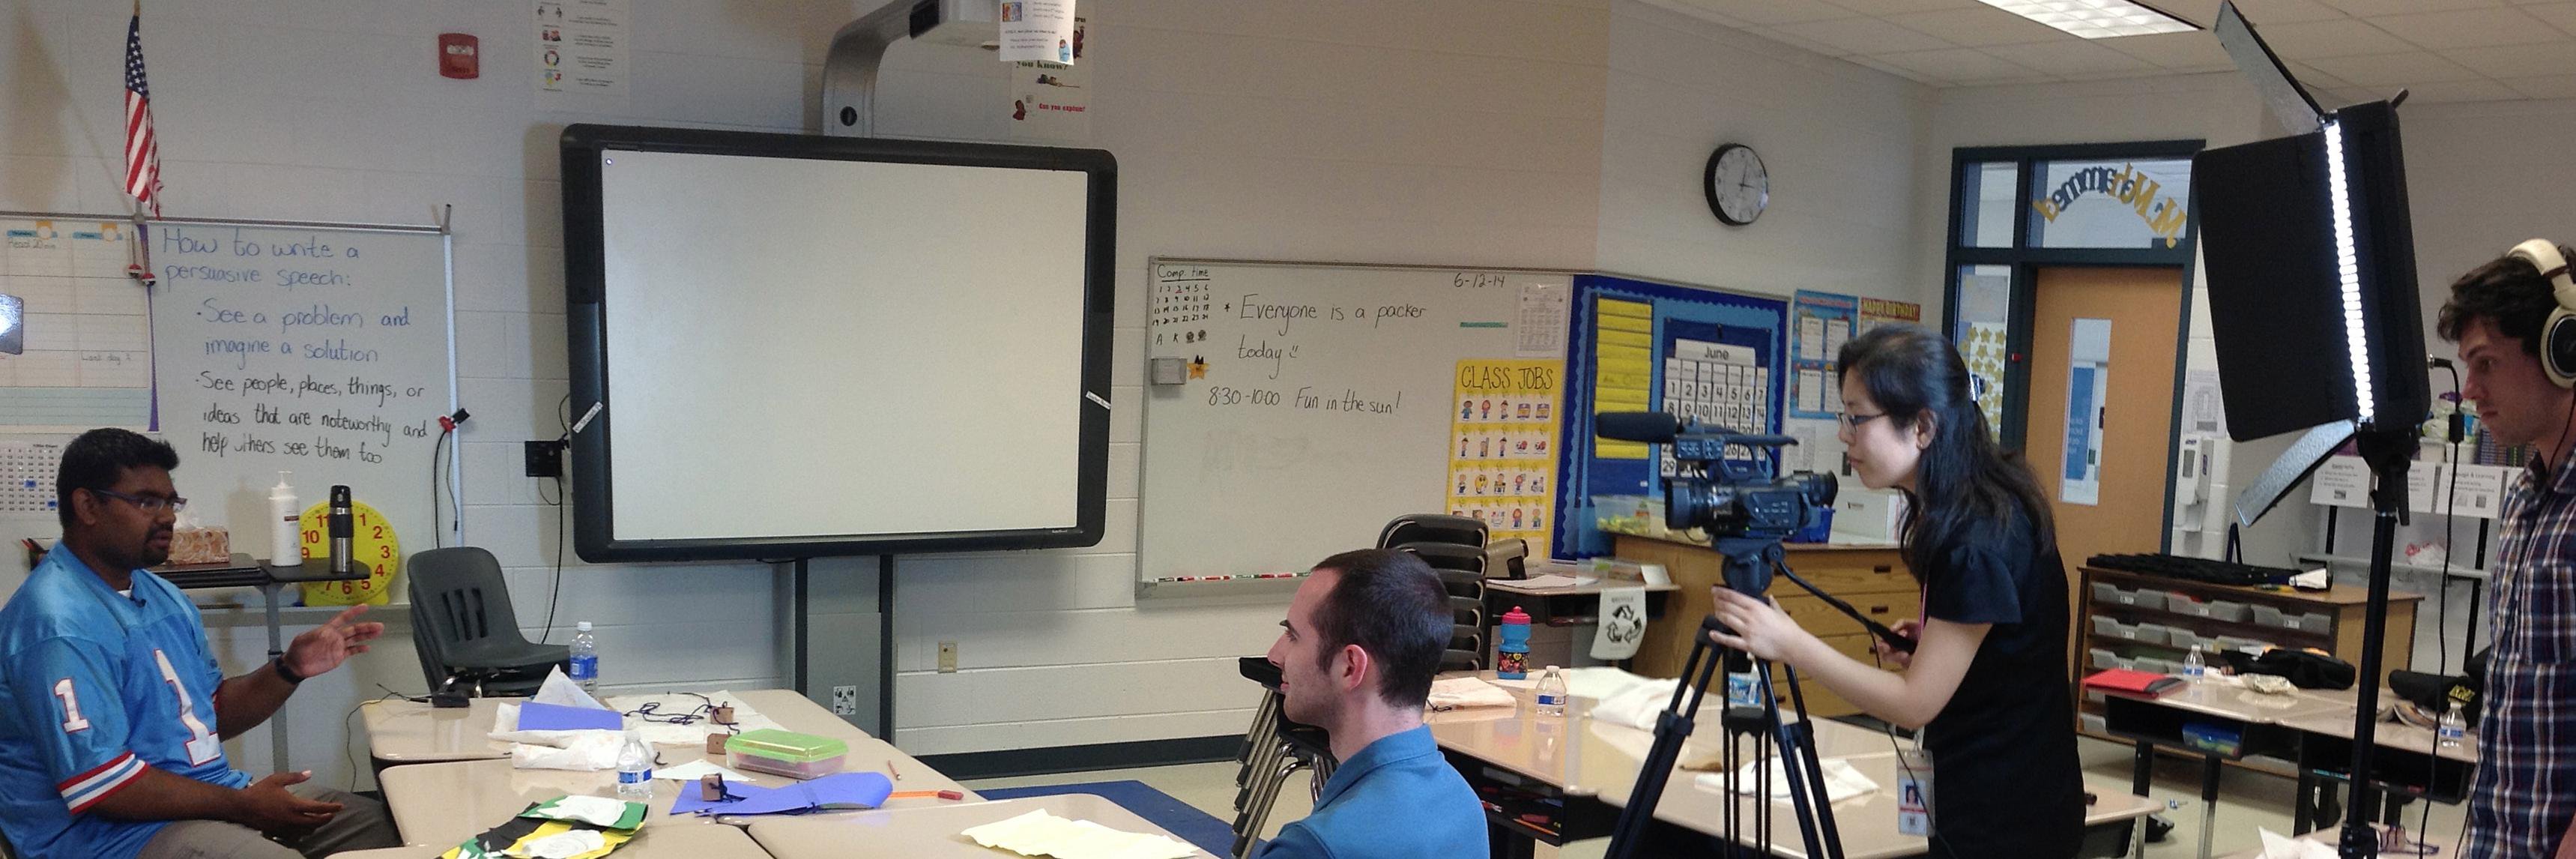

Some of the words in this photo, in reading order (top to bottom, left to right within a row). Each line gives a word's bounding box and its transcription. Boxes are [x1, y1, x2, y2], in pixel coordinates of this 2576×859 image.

[163, 228, 218, 254] How
[234, 227, 261, 256] to
[272, 235, 334, 258] write
[346, 247, 360, 258] a
[166, 265, 262, 293] persuasive
[276, 269, 351, 292] speech:
[1454, 273, 1505, 288] 6-12-14
[203, 297, 247, 324] See
[253, 313, 267, 324] a
[282, 304, 363, 334] problem
[381, 306, 411, 326] and
[1240, 294, 1318, 337] Everyone
[1330, 304, 1345, 321] is
[1355, 307, 1365, 319] a
[1374, 303, 1427, 328] packer
[205, 339, 270, 370] imagine
[281, 342, 292, 354] a
[304, 339, 378, 362] solution
[1238, 334, 1282, 379] today
[1705, 347, 1729, 360] June
[1462, 366, 1511, 389] CLASS
[1518, 367, 1553, 389] JOBS
[200, 371, 235, 391] See
[243, 373, 294, 397] people,
[298, 375, 342, 398] places,
[348, 377, 397, 408] things,
[406, 388, 426, 397] or
[1295, 386, 1319, 409] Fun
[1326, 397, 1337, 410] in
[1343, 389, 1364, 412] the
[1370, 391, 1401, 414] sun!
[1670, 382, 1676, 393] 1
[1685, 384, 1693, 397] 2
[1702, 385, 1708, 398] 3
[1717, 388, 1723, 400] 4
[1732, 389, 1737, 400] 5
[1744, 390, 1751, 401] 6
[1758, 390, 1764, 400] 7
[1668, 403, 1675, 414] 8
[1684, 402, 1691, 415] 9
[1699, 404, 1709, 418] 10
[1714, 406, 1723, 418] 11
[1727, 406, 1738, 419] 12
[1742, 406, 1751, 419] 13
[1756, 407, 1765, 419] 14
[203, 403, 240, 425] ideas
[255, 403, 281, 425] that
[288, 412, 312, 427] are
[321, 409, 391, 447] noteworthy
[404, 421, 428, 438] and
[202, 432, 229, 458] help
[284, 441, 309, 456] see
[315, 436, 351, 460] them
[360, 442, 382, 464] too
[1662, 459, 1675, 471] 29
[360, 513, 366, 525] 1
[303, 530, 319, 543] 10
[373, 526, 382, 539] 2
[301, 547, 310, 558] 9
[381, 546, 390, 558] 3
[375, 564, 384, 576] 4
[342, 581, 351, 594] 6
[361, 579, 370, 590] 5
[53, 678, 90, 735] 1
[153, 648, 222, 768] 1
